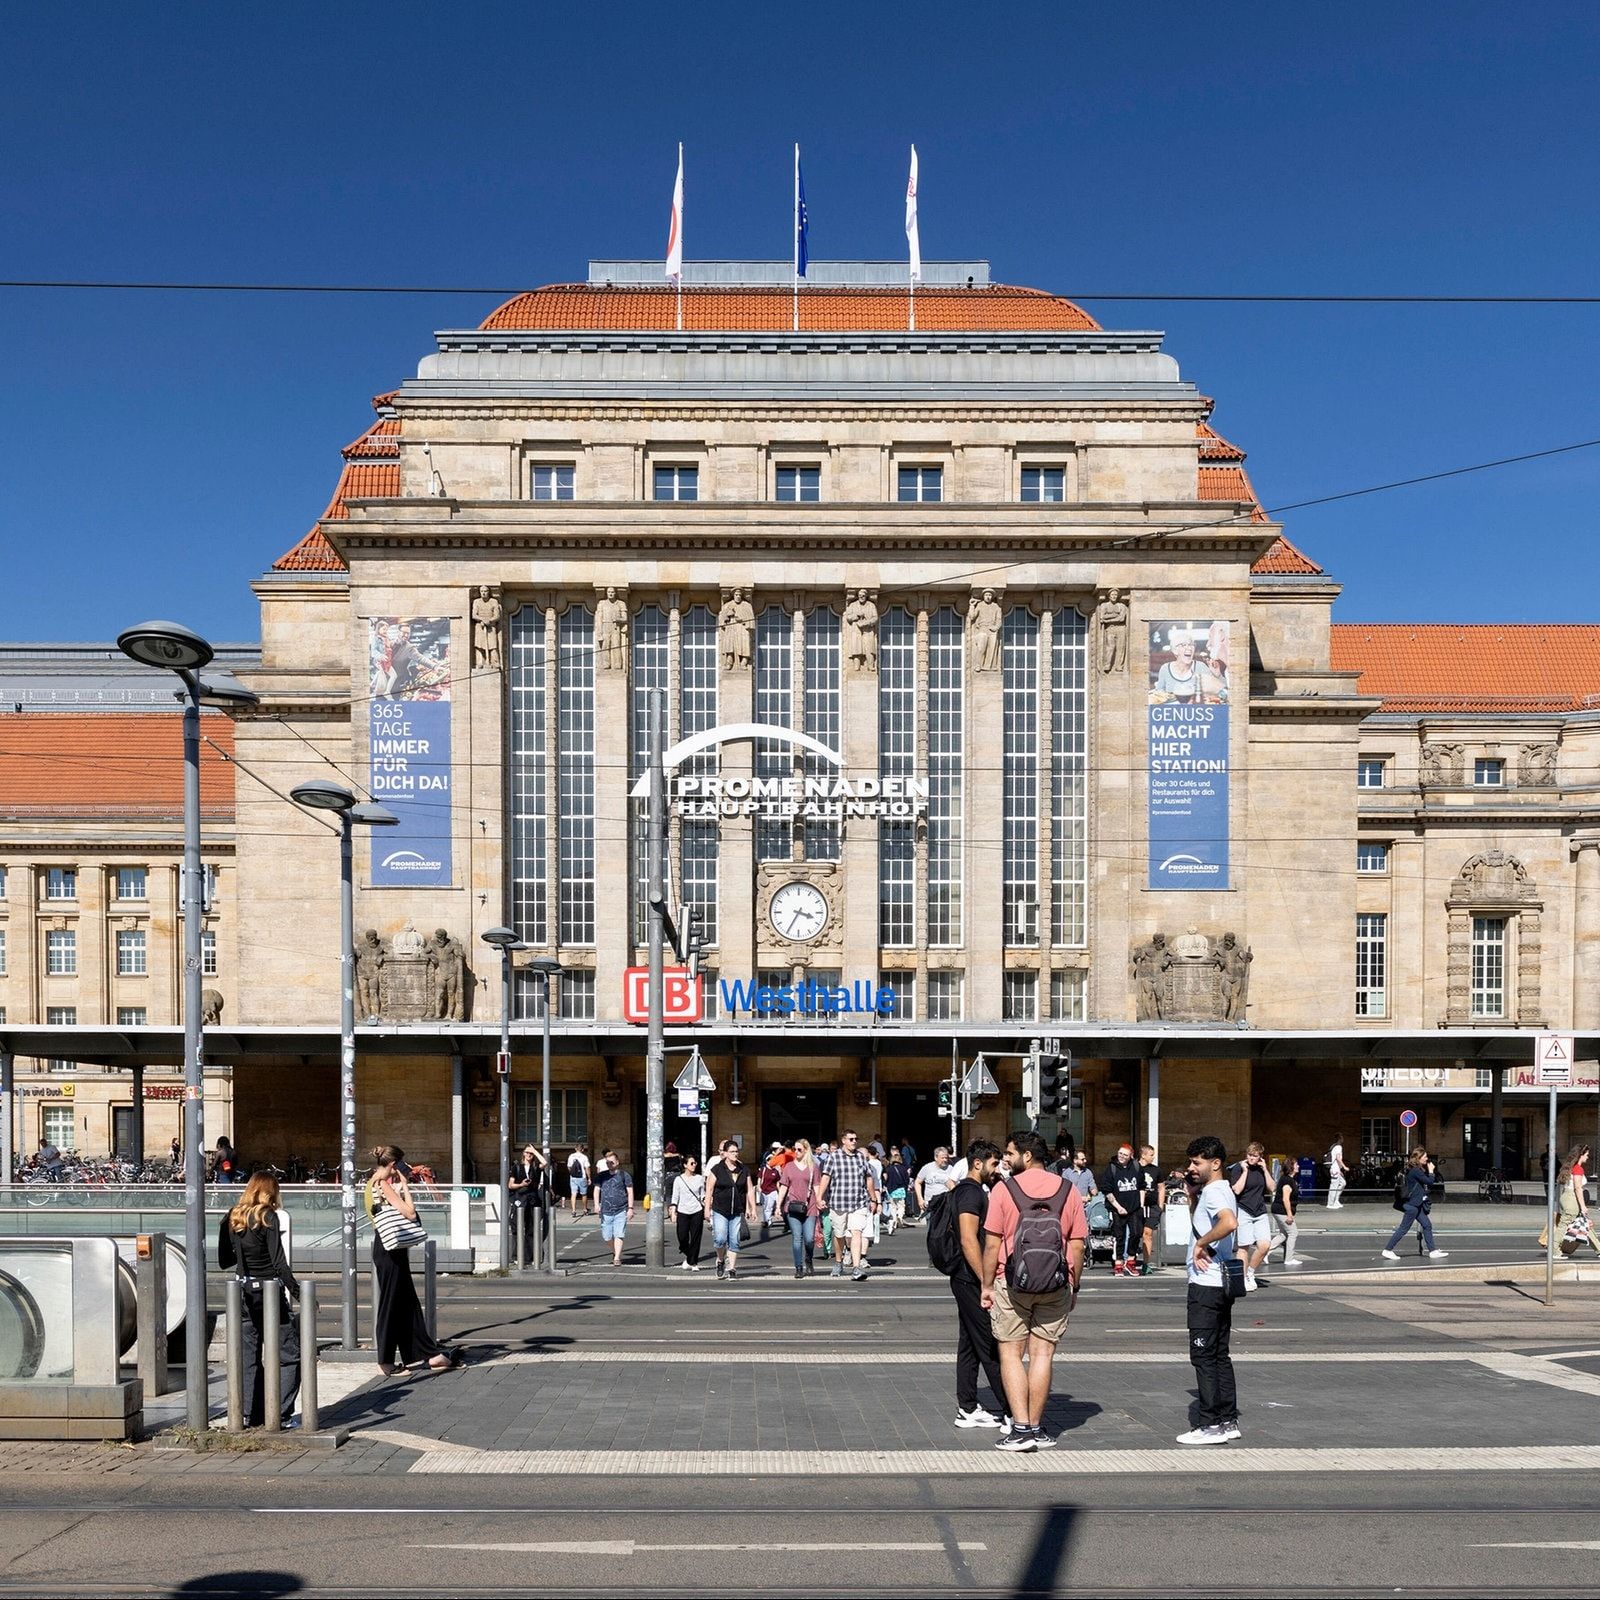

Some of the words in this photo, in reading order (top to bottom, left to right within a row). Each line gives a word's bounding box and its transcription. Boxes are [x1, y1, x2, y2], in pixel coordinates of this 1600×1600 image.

[373, 704, 403, 718] 365
[1152, 707, 1214, 721] GENUSS
[373, 722, 413, 736] TAGE
[1152, 725, 1211, 739] MACHT
[373, 740, 430, 754] IMMER
[1152, 742, 1192, 756] HIER
[373, 754, 408, 772] FÜR
[1152, 760, 1226, 774] STATION!
[373, 775, 415, 790] DICH
[419, 775, 449, 790] DA!
[678, 777, 930, 798] PROMENADEN
[1152, 779, 1168, 787] Über
[678, 801, 930, 815] HAUPTBAHNHOF
[635, 977, 691, 1013] DB
[720, 978, 897, 1013] Westhalle
